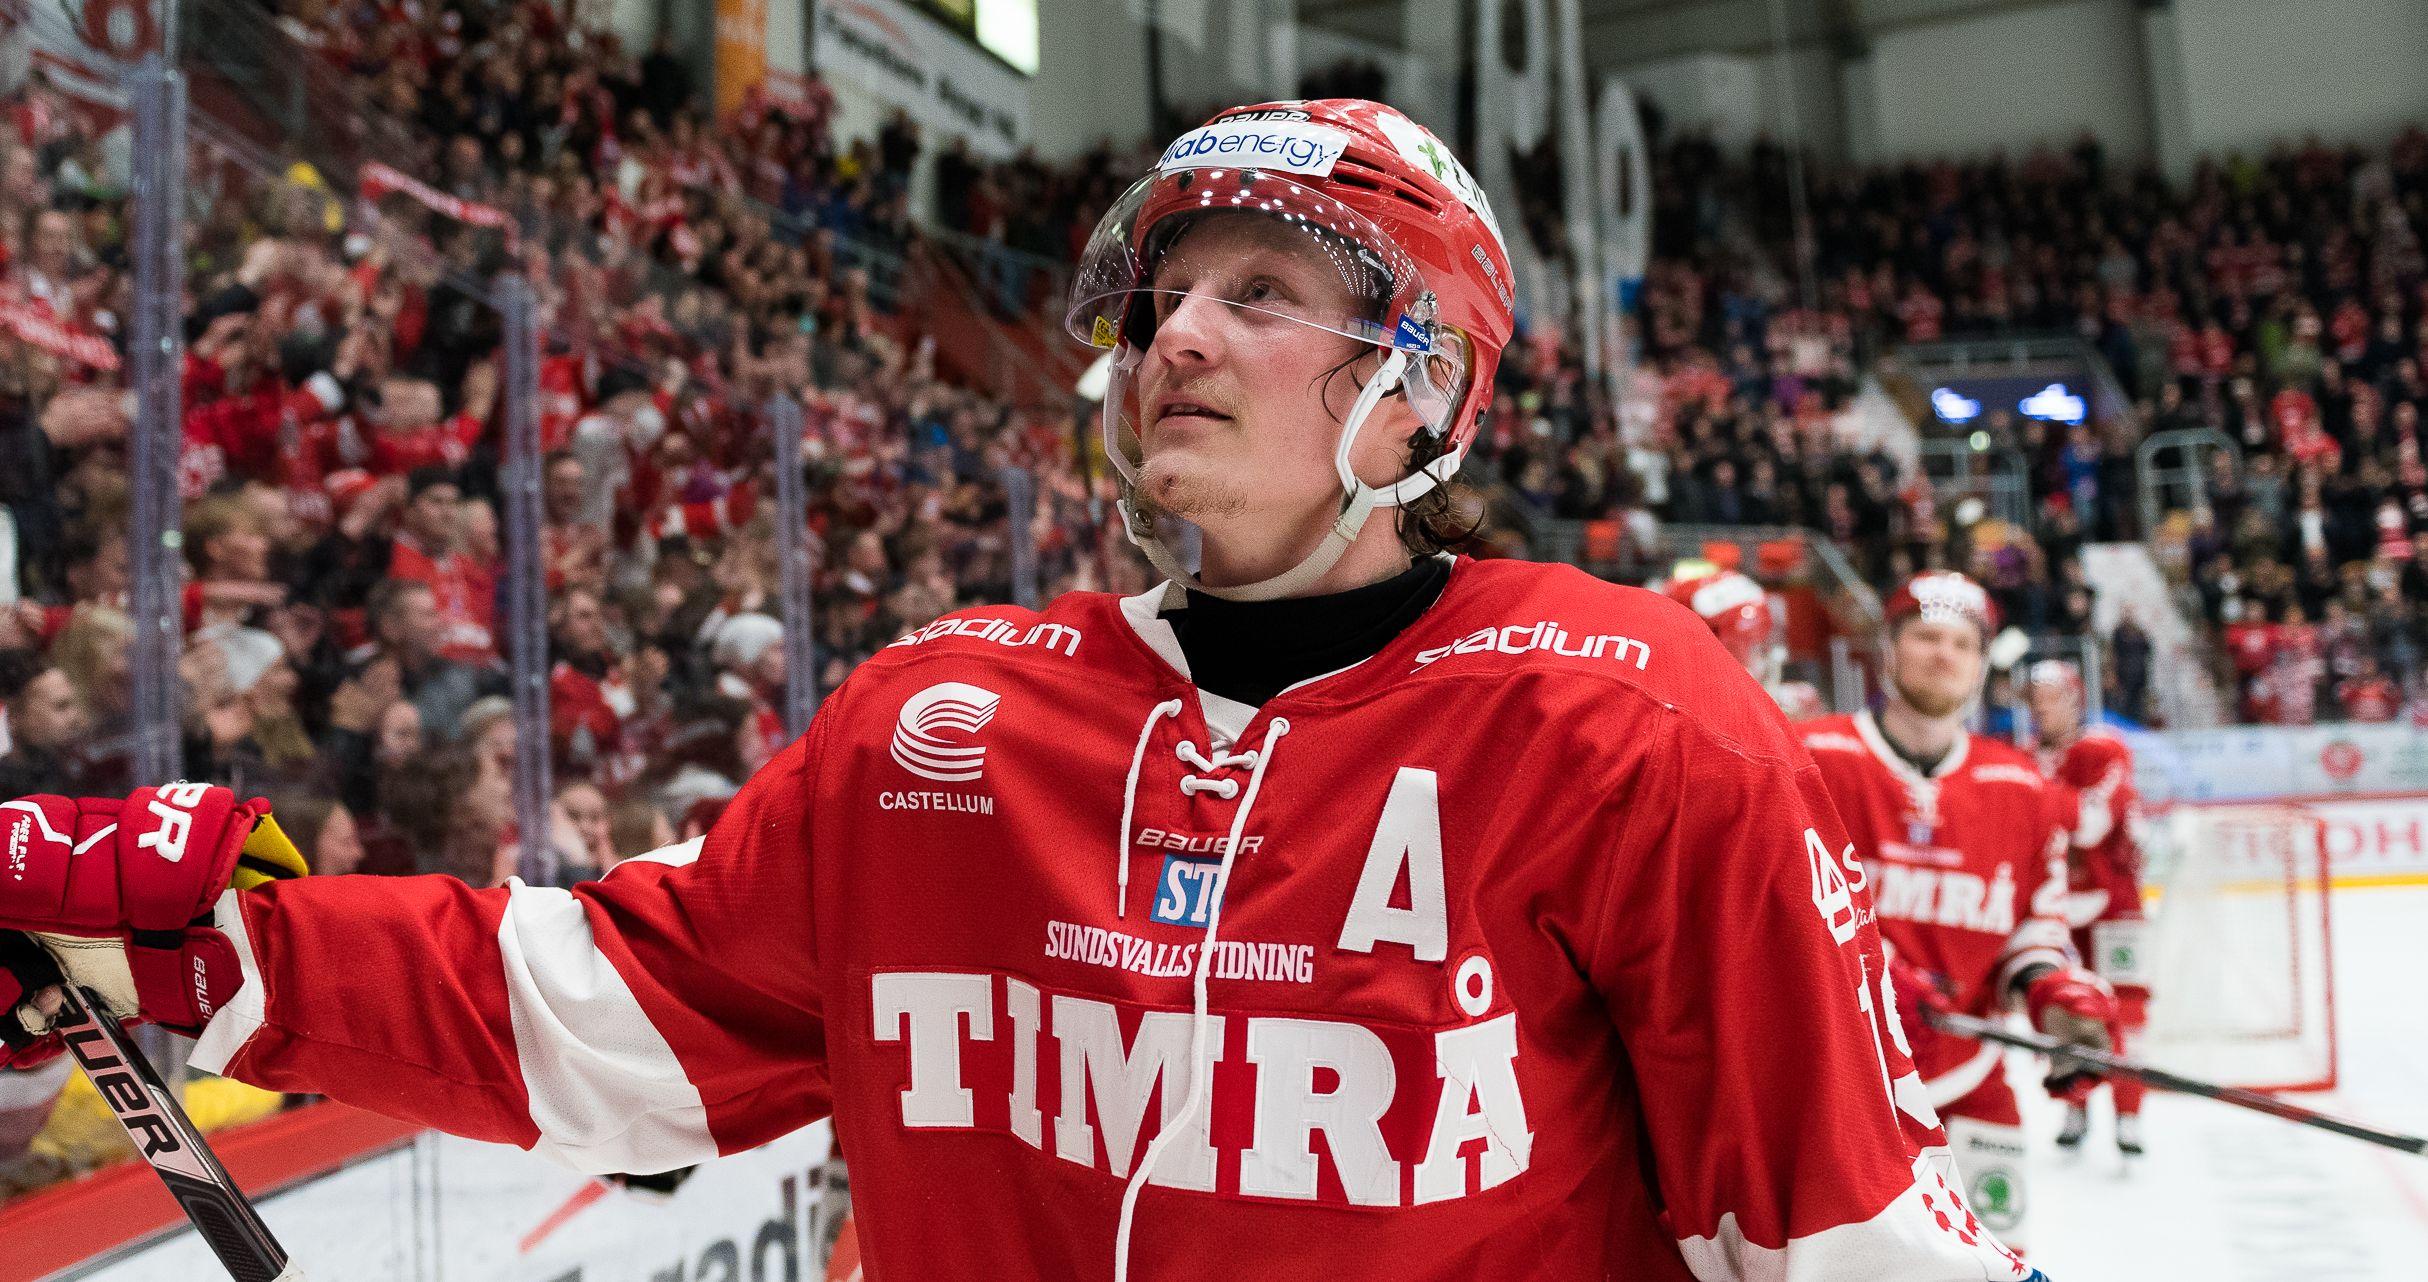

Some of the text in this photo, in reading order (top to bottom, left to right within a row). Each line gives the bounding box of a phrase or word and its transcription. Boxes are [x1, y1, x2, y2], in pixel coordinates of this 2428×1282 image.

[1400, 320, 1430, 347] BAUER
[885, 617, 1083, 658] stadium
[1409, 620, 1651, 675] stadium
[878, 791, 994, 816] CASTELLUM
[1136, 827, 1264, 854] BAUER
[1338, 766, 1449, 962] A
[1157, 859, 1220, 923] ST
[1044, 920, 1197, 978] SUNDSVALLS
[193, 954, 214, 1022] BAUE
[871, 954, 1533, 1207] TIMRÅ
